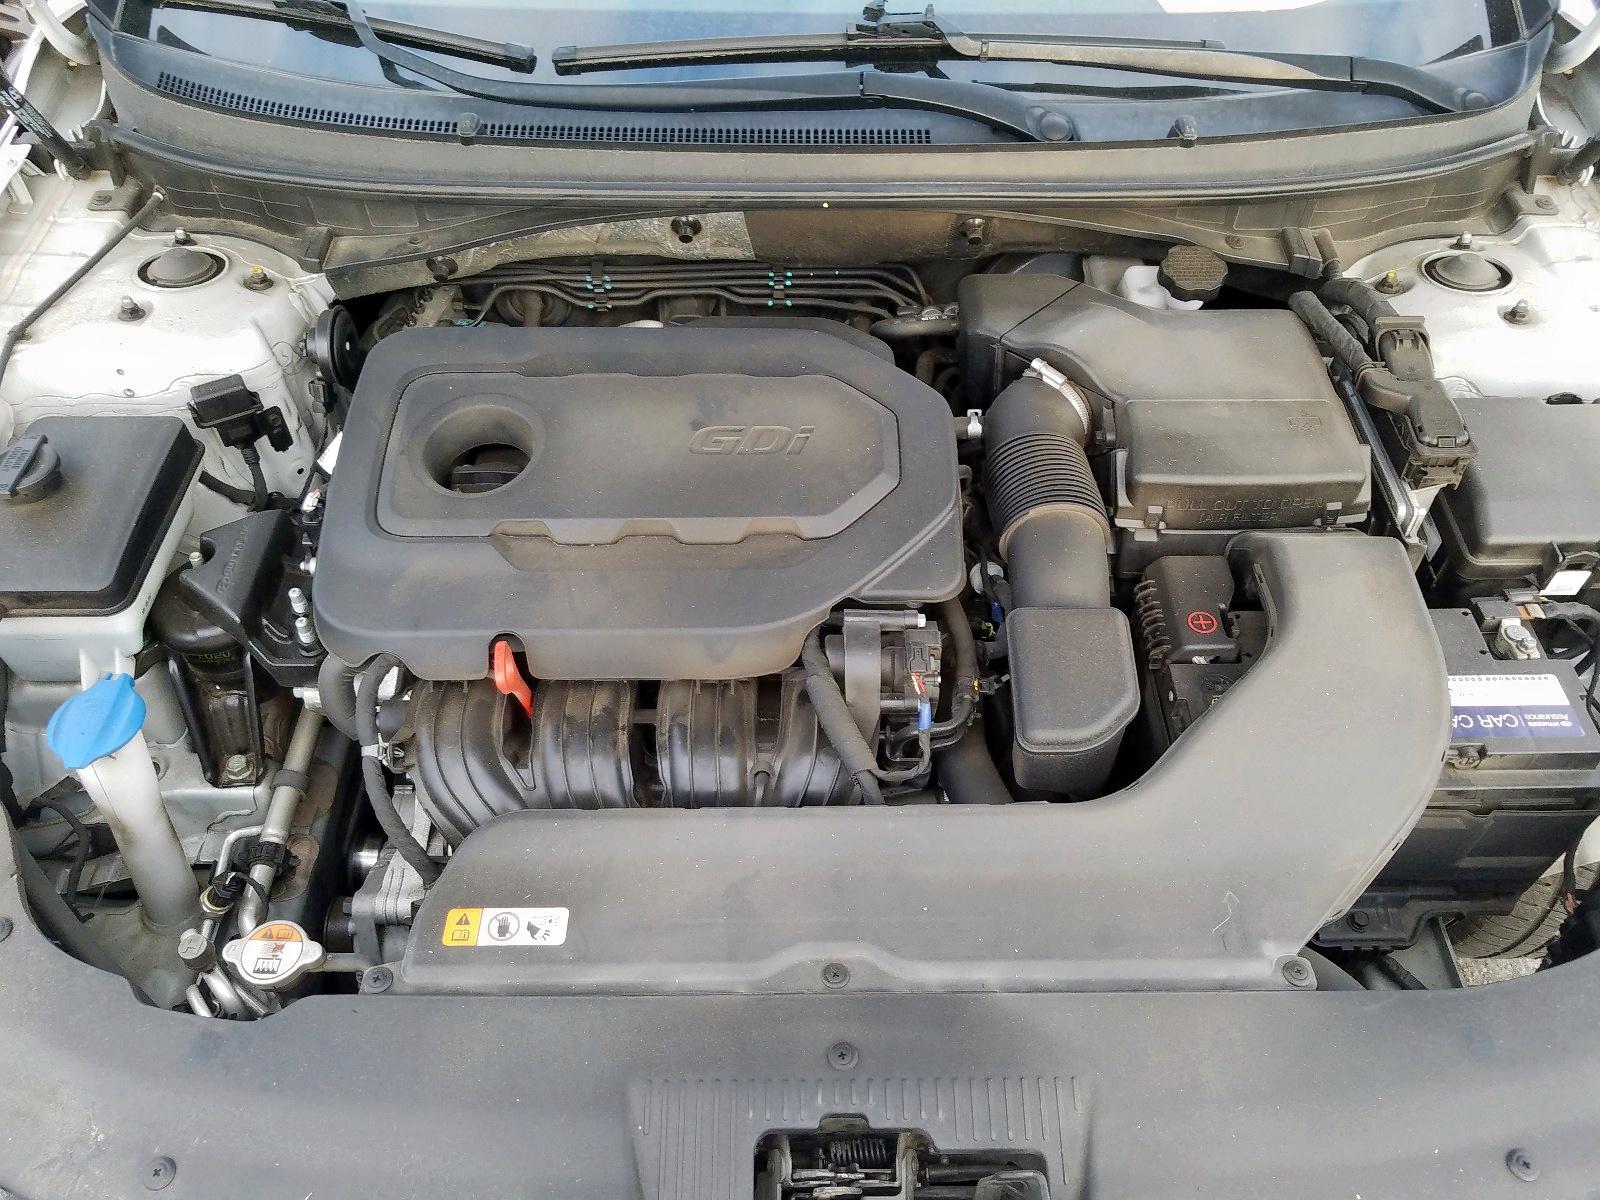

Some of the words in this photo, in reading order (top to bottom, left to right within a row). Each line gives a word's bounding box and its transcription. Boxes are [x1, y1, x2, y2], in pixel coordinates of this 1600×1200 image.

[688, 425, 815, 455] GDi
[1212, 499, 1249, 511] OUT
[1476, 713, 1519, 729] CAR
